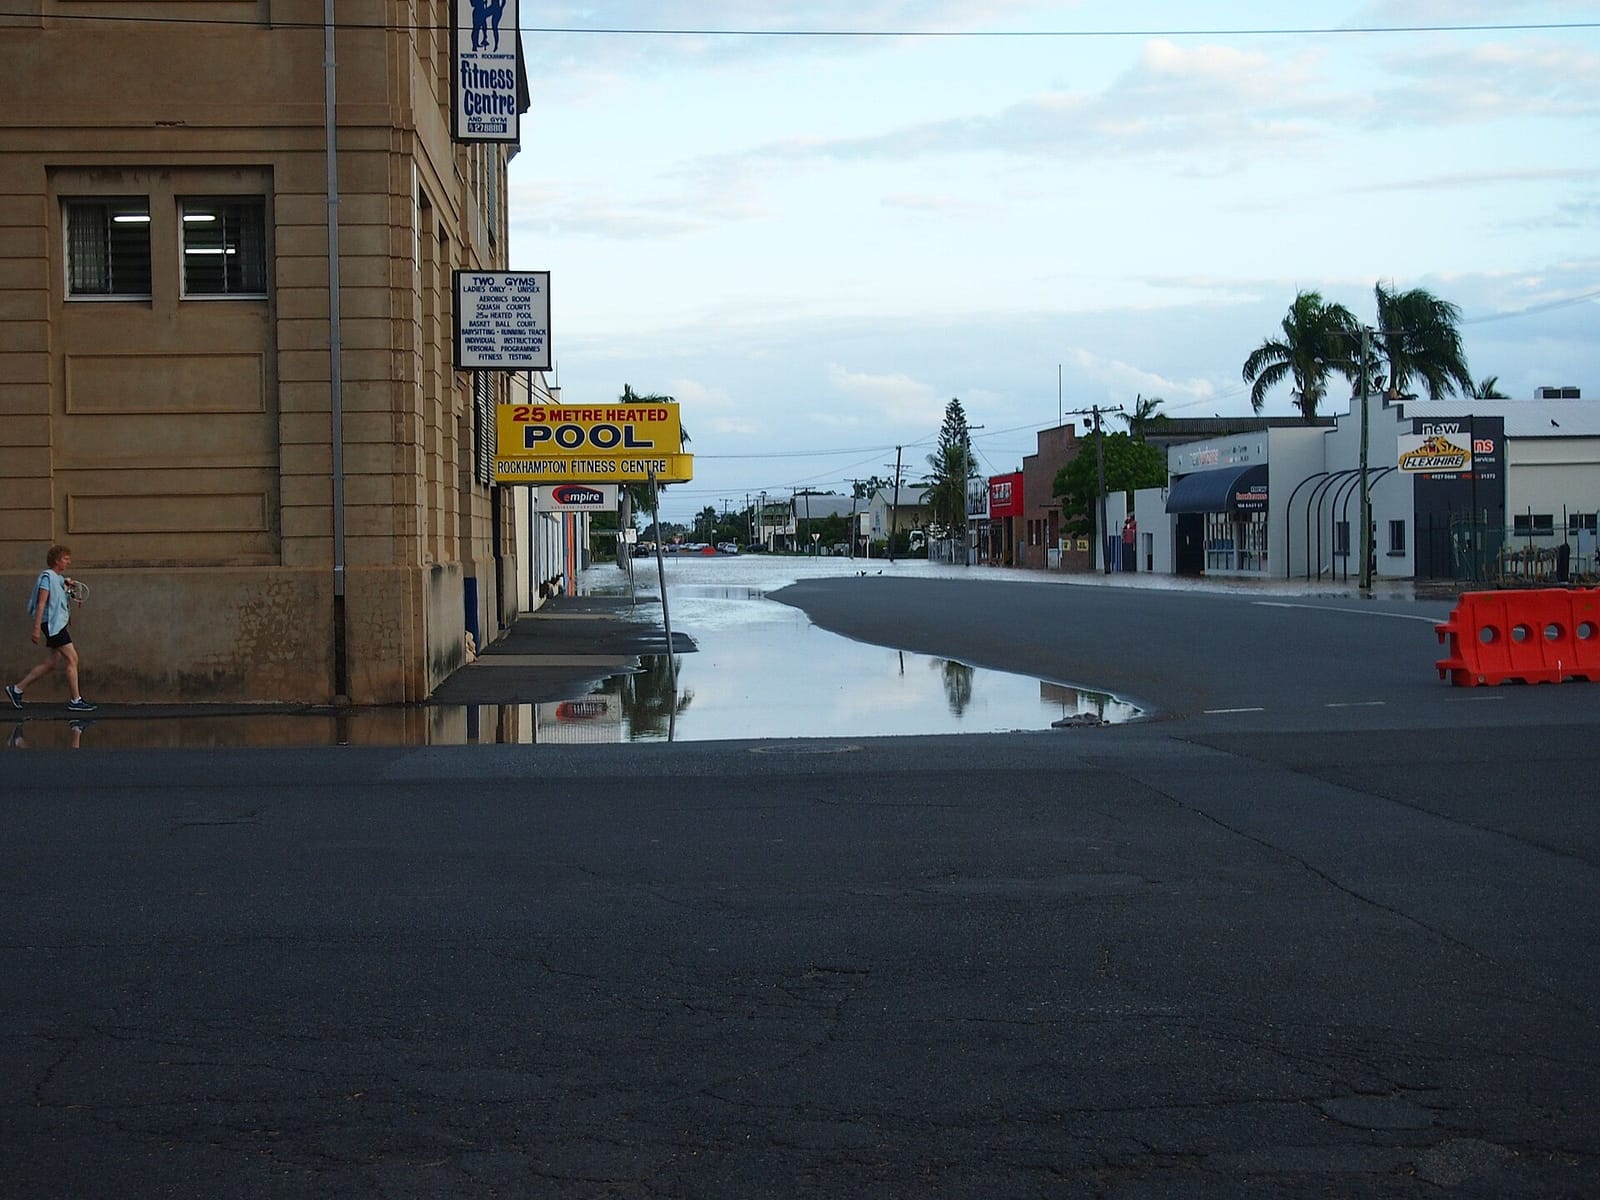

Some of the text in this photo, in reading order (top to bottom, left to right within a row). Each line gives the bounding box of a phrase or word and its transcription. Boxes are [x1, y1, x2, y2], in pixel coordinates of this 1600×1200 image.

[464, 89, 515, 116] Centre
[472, 277, 536, 286] TWO GYMS
[512, 406, 668, 422] 25 METRE HEATED
[1422, 423, 1460, 435] new
[523, 423, 655, 449] POOL
[497, 459, 667, 474] ROCKHAMPTON FITNESS CENTRE
[1405, 455, 1464, 467] FLEXIHIRE
[563, 491, 600, 503] empire
